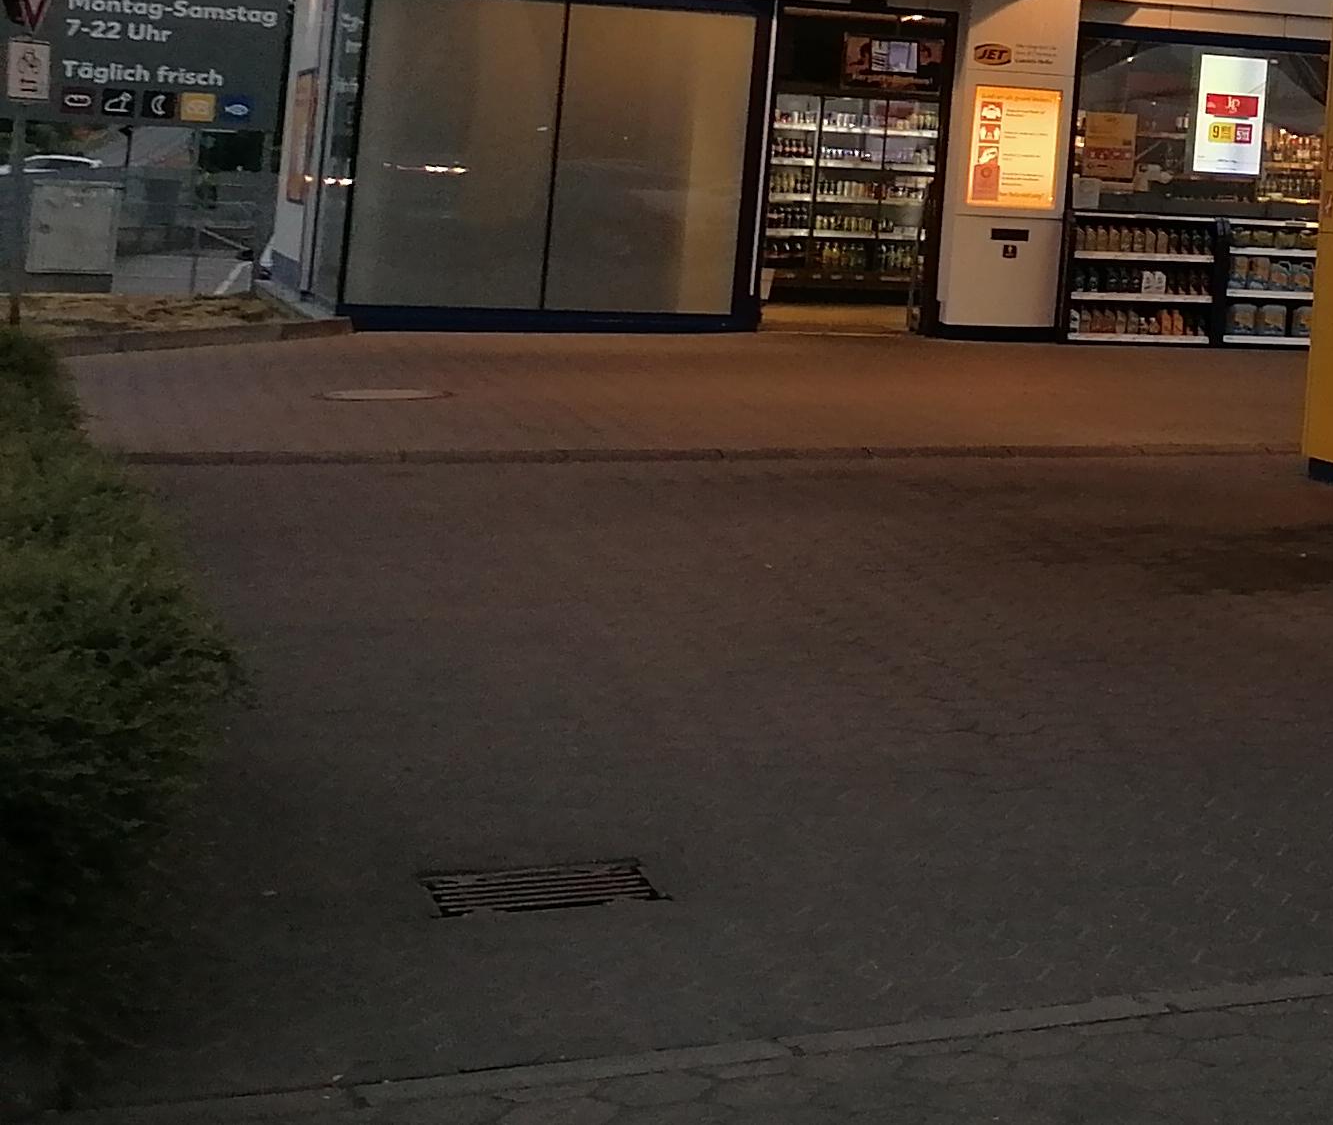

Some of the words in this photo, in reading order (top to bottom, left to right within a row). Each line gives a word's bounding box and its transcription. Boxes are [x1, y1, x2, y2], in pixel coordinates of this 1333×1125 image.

[66, 18, 121, 39] 7-22
[127, 23, 173, 43] Uhr
[977, 49, 1008, 60] JET
[62, 60, 150, 84] Täglich
[157, 65, 224, 86] frisch
[1212, 125, 1220, 139] 9
